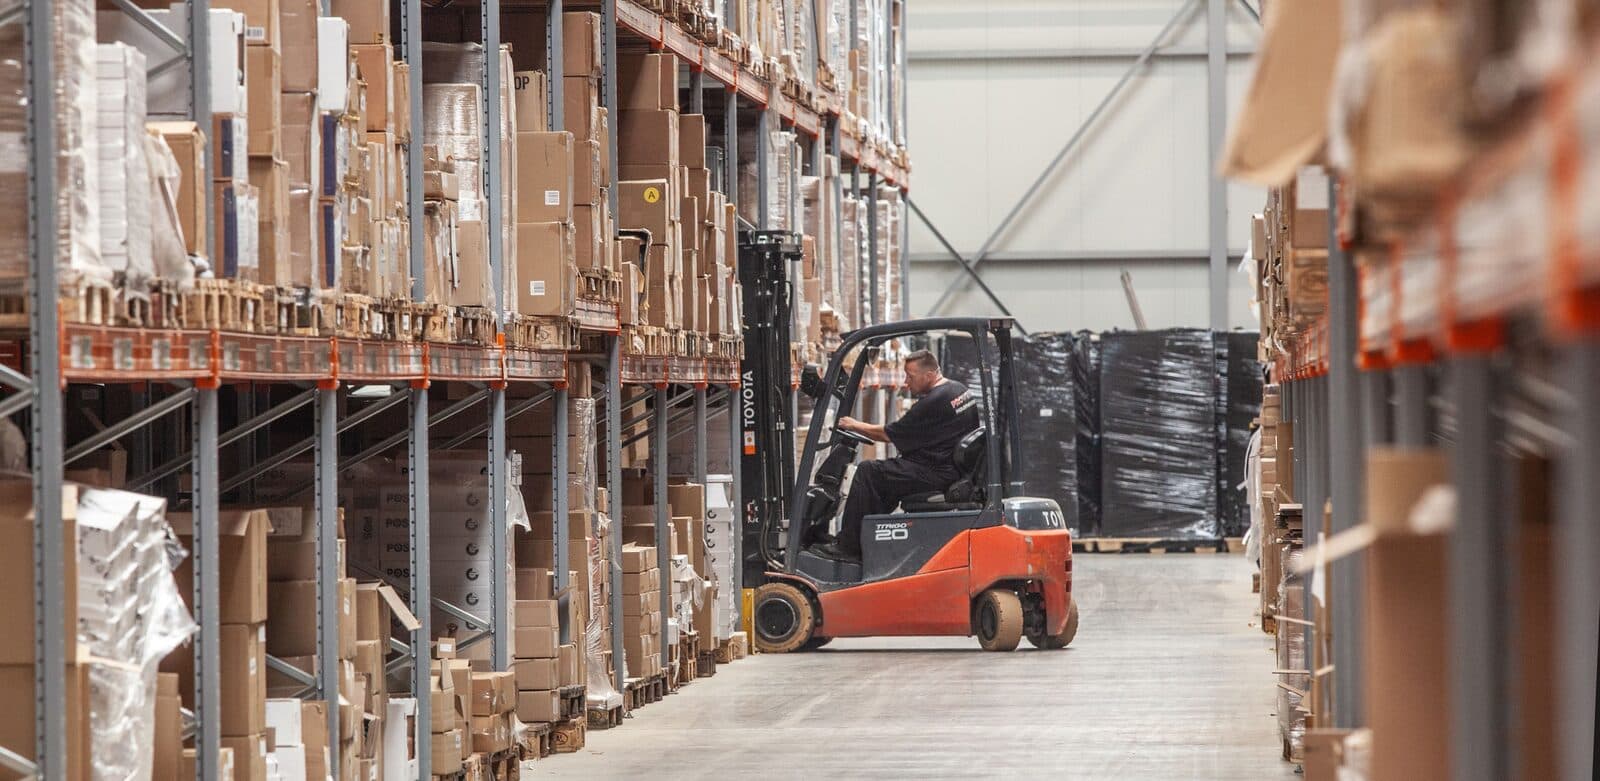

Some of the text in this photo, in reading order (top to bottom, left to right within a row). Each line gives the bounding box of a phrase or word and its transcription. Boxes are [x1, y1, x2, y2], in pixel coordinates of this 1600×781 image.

[742, 370, 756, 428] TOYOTA
[875, 529, 909, 541] 20
[386, 567, 410, 578] POS
